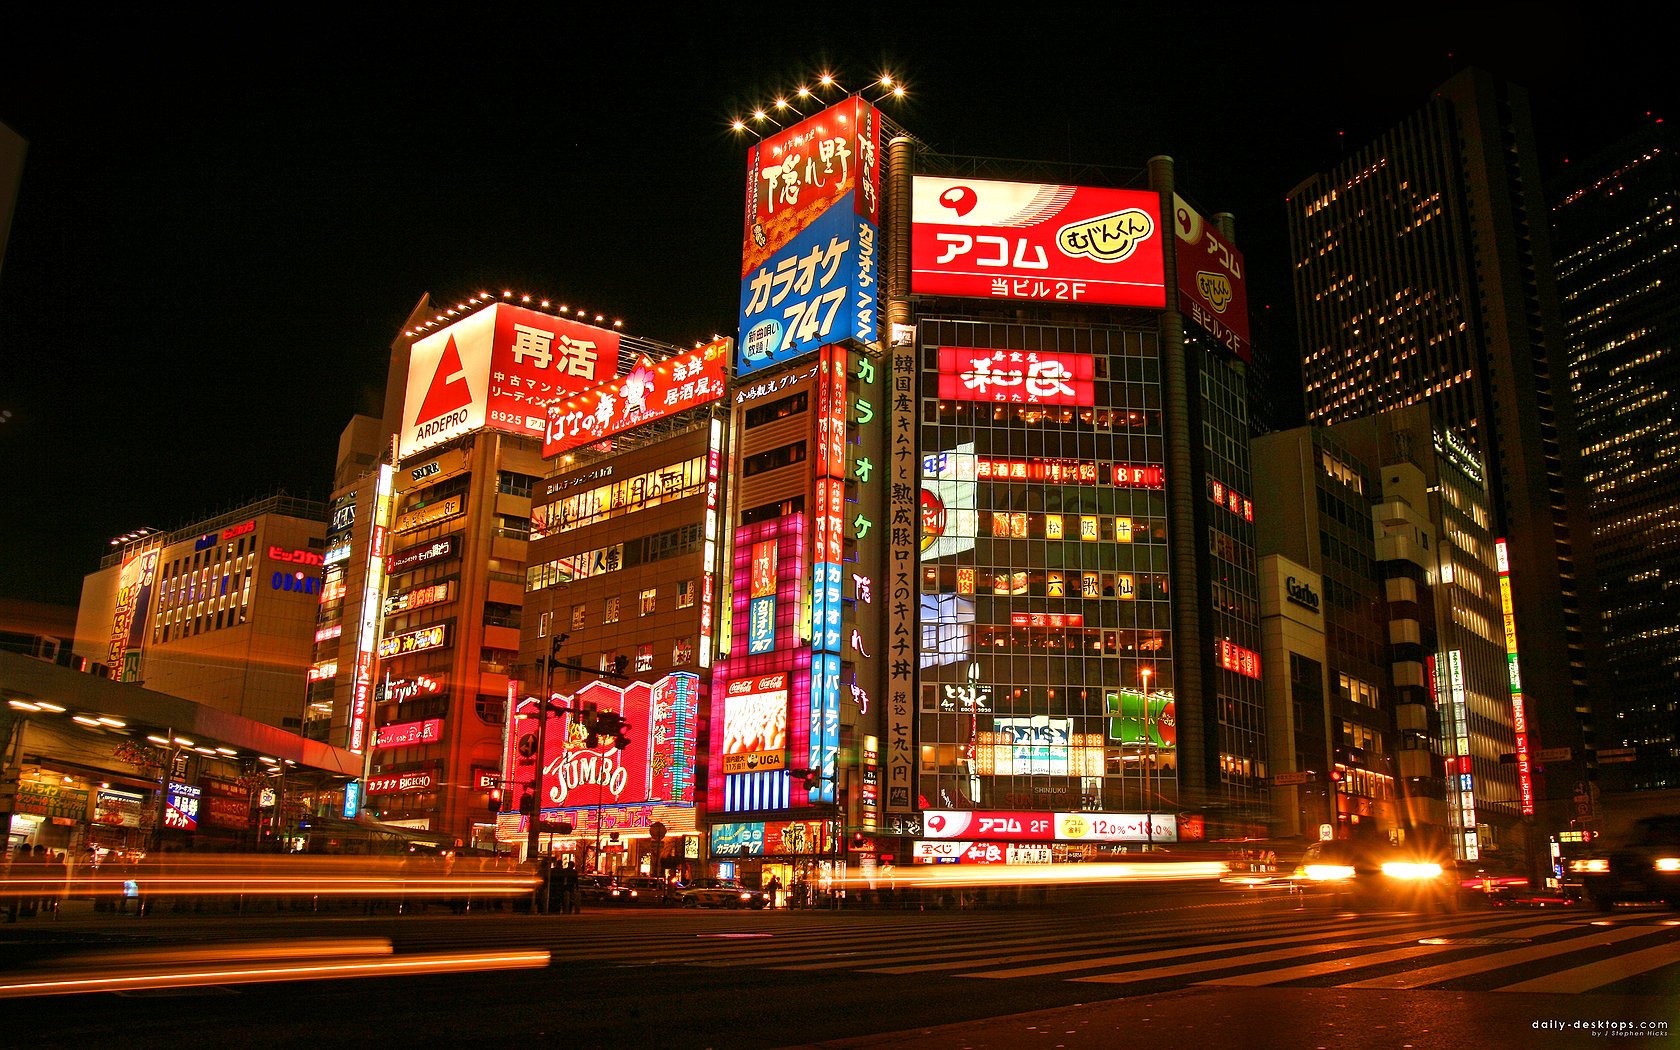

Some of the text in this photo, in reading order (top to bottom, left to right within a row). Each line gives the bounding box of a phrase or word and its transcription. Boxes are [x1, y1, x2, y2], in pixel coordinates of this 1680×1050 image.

[762, 136, 851, 214] 隠れ野
[1066, 216, 1146, 255] むじんくん
[858, 224, 873, 288] カラオケ
[936, 232, 1049, 270] アコム
[1206, 231, 1241, 278] アコム
[744, 237, 850, 318] カラオケ
[991, 279, 1087, 300] 当ビル 2F
[780, 286, 847, 352] 747
[511, 323, 598, 380] 再活
[672, 358, 704, 381] 海鮮
[664, 377, 711, 405] 居酒屋
[416, 408, 469, 442] ARDEPRO
[490, 410, 522, 425] 8925
[546, 392, 617, 445] はなの舞
[854, 357, 875, 539] カラオケ
[1117, 467, 1143, 483] 8F
[444, 502, 456, 514] 8F
[1047, 521, 1131, 537] 松阪牛
[1048, 576, 1133, 597] 六歌仙
[1286, 576, 1320, 607] Garbo
[814, 567, 825, 646] カラオケ
[827, 566, 841, 646] カラオケ
[758, 675, 784, 690] Coca-Cola
[760, 755, 780, 764] UGA
[369, 778, 397, 791] カラオケ
[543, 747, 628, 803] JUMBO
[165, 807, 189, 828] チケット
[587, 806, 654, 830] ジャンボ
[979, 818, 1049, 833] アコム 2F
[716, 843, 741, 854] カラオケ
[922, 844, 952, 855] 宝くじ
